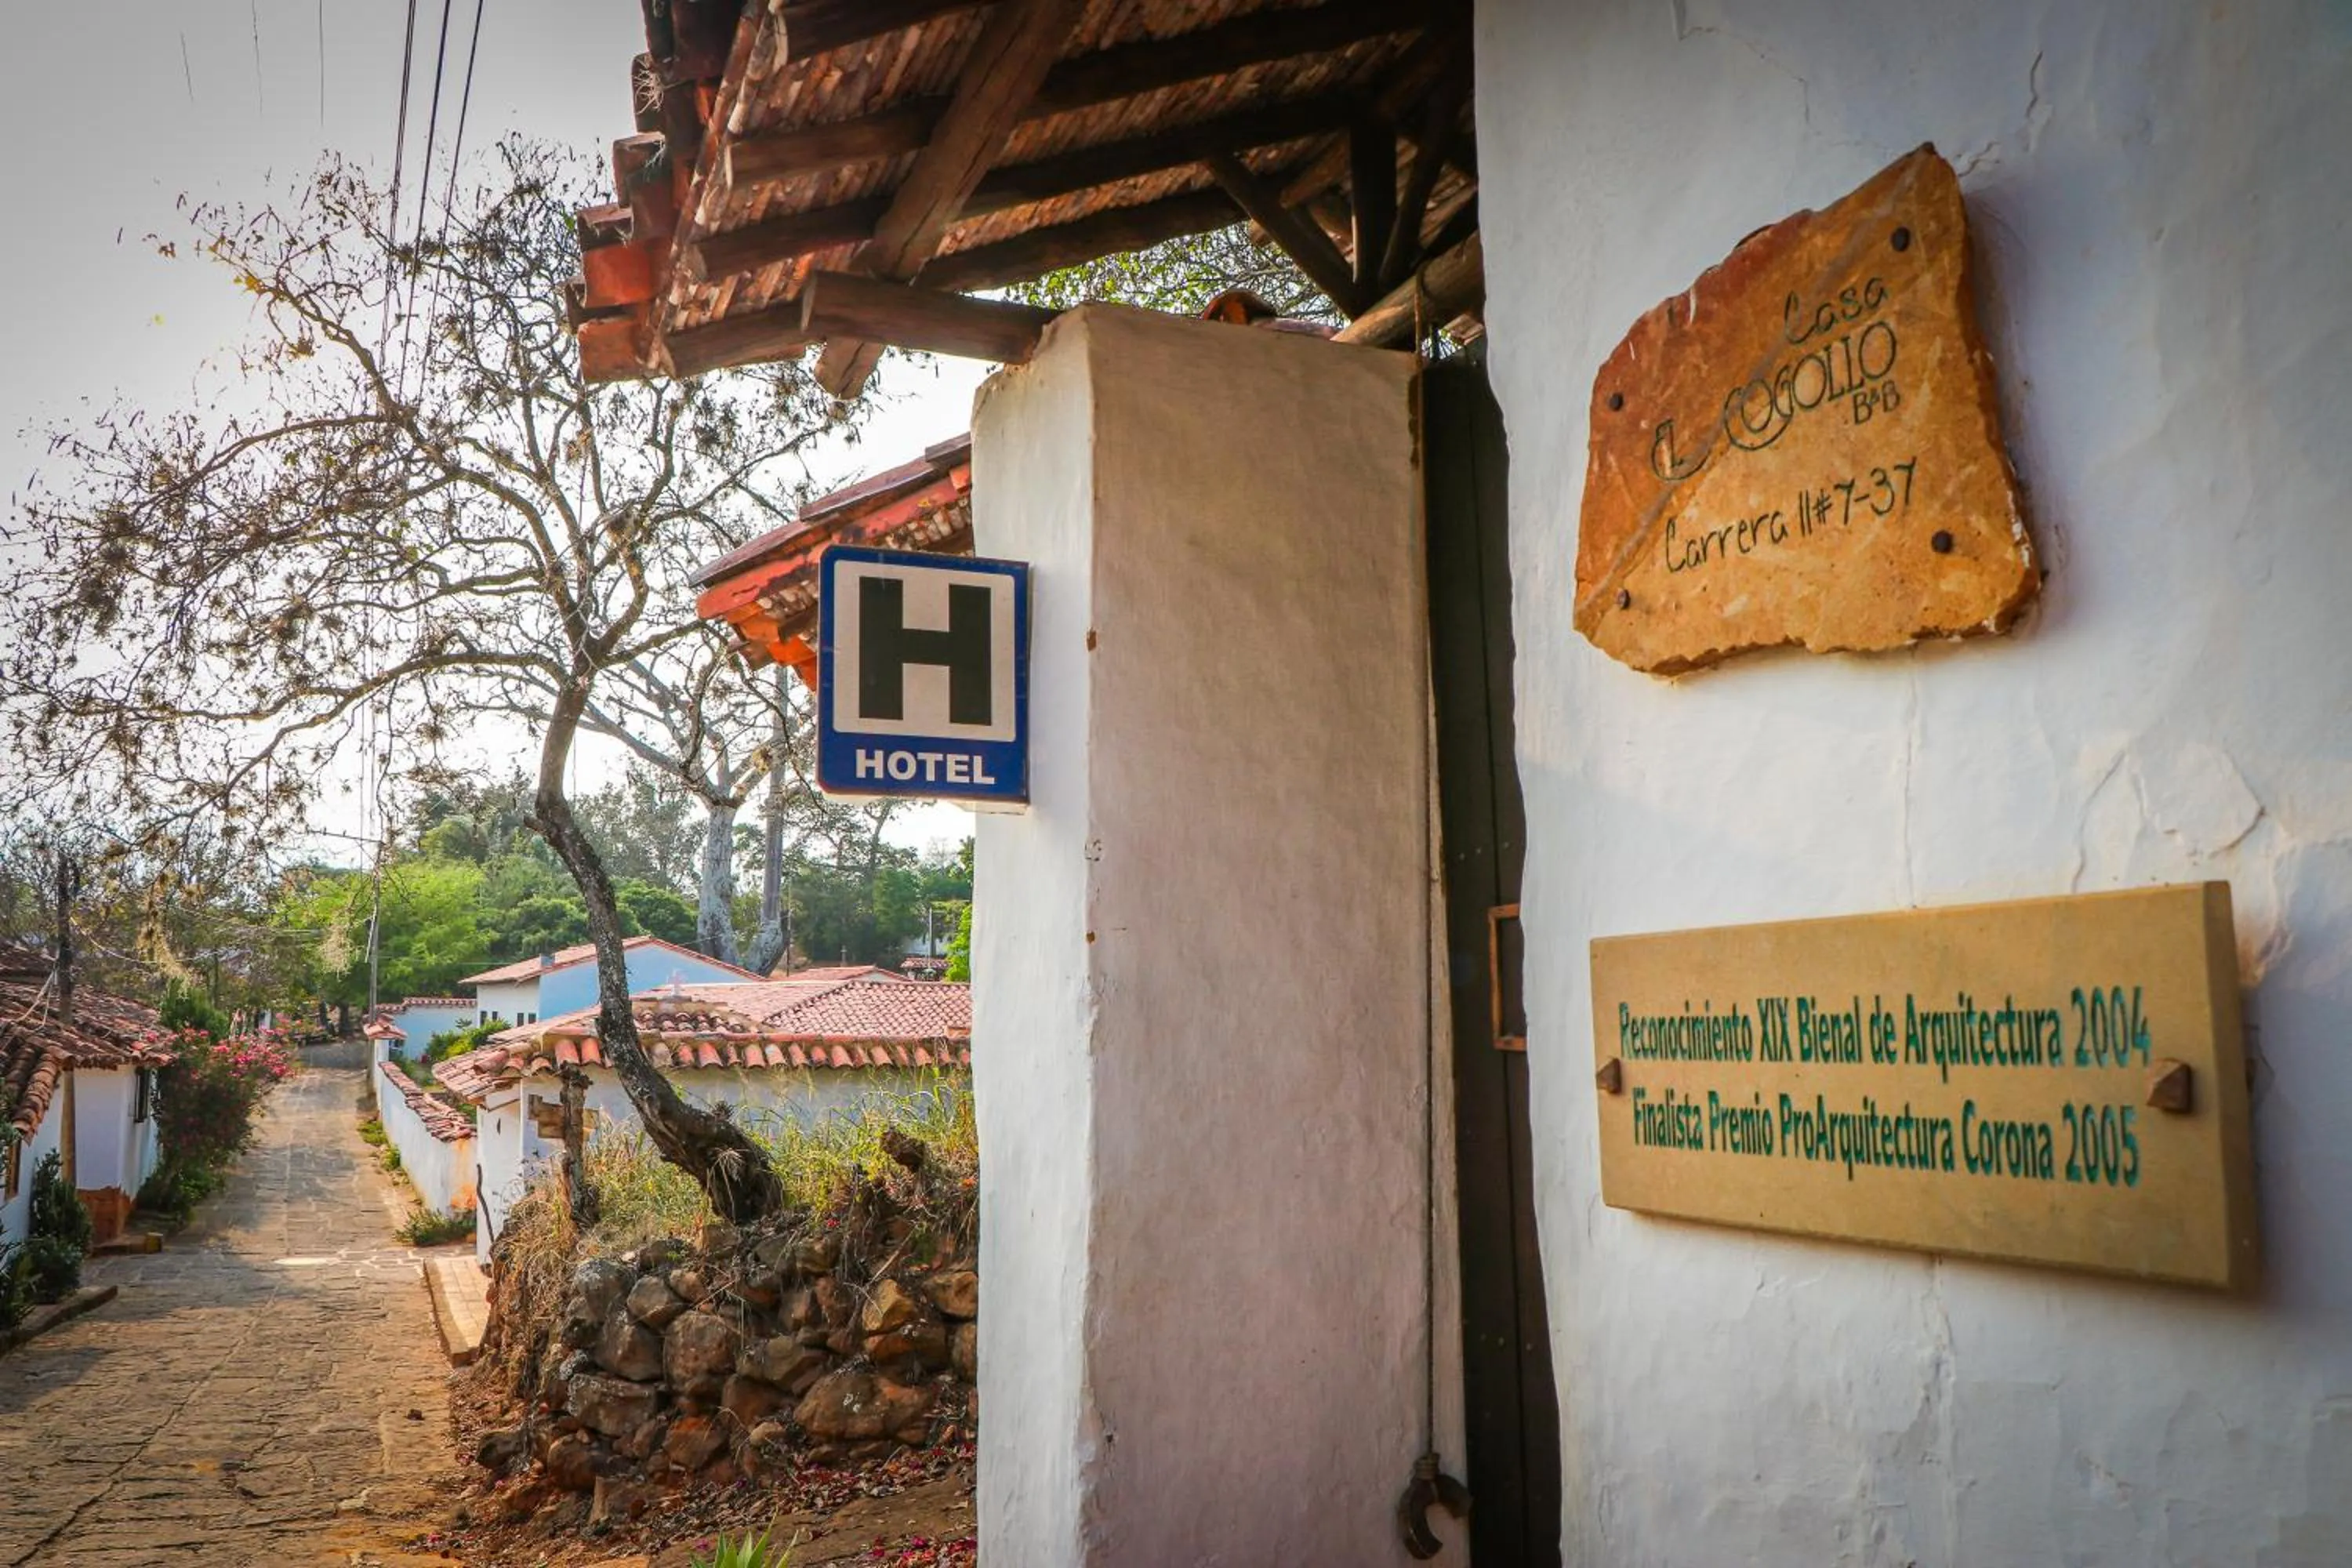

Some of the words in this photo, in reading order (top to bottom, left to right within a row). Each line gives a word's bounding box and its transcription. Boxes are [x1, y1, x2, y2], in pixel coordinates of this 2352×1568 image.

[1784, 277, 1888, 345] Casa
[1725, 321, 1896, 452] COGOLLO
[1665, 517, 1788, 573] Carrera
[858, 576, 992, 726] H
[855, 749, 995, 785] HOTEL
[1618, 999, 1753, 1062] Reconocimiento
[1756, 997, 1792, 1062] XIX
[1796, 995, 1863, 1063] Bienal
[1868, 995, 1896, 1064] de
[1904, 991, 2063, 1083] Arquitectura
[2071, 985, 2151, 1067] 2004
[1632, 1087, 1704, 1150] Finalista
[1708, 1091, 1774, 1156] Premio
[1778, 1093, 1955, 1181] ProArquitectura
[1962, 1099, 2054, 1179] Corona
[2062, 1100, 2140, 1188] 2005
